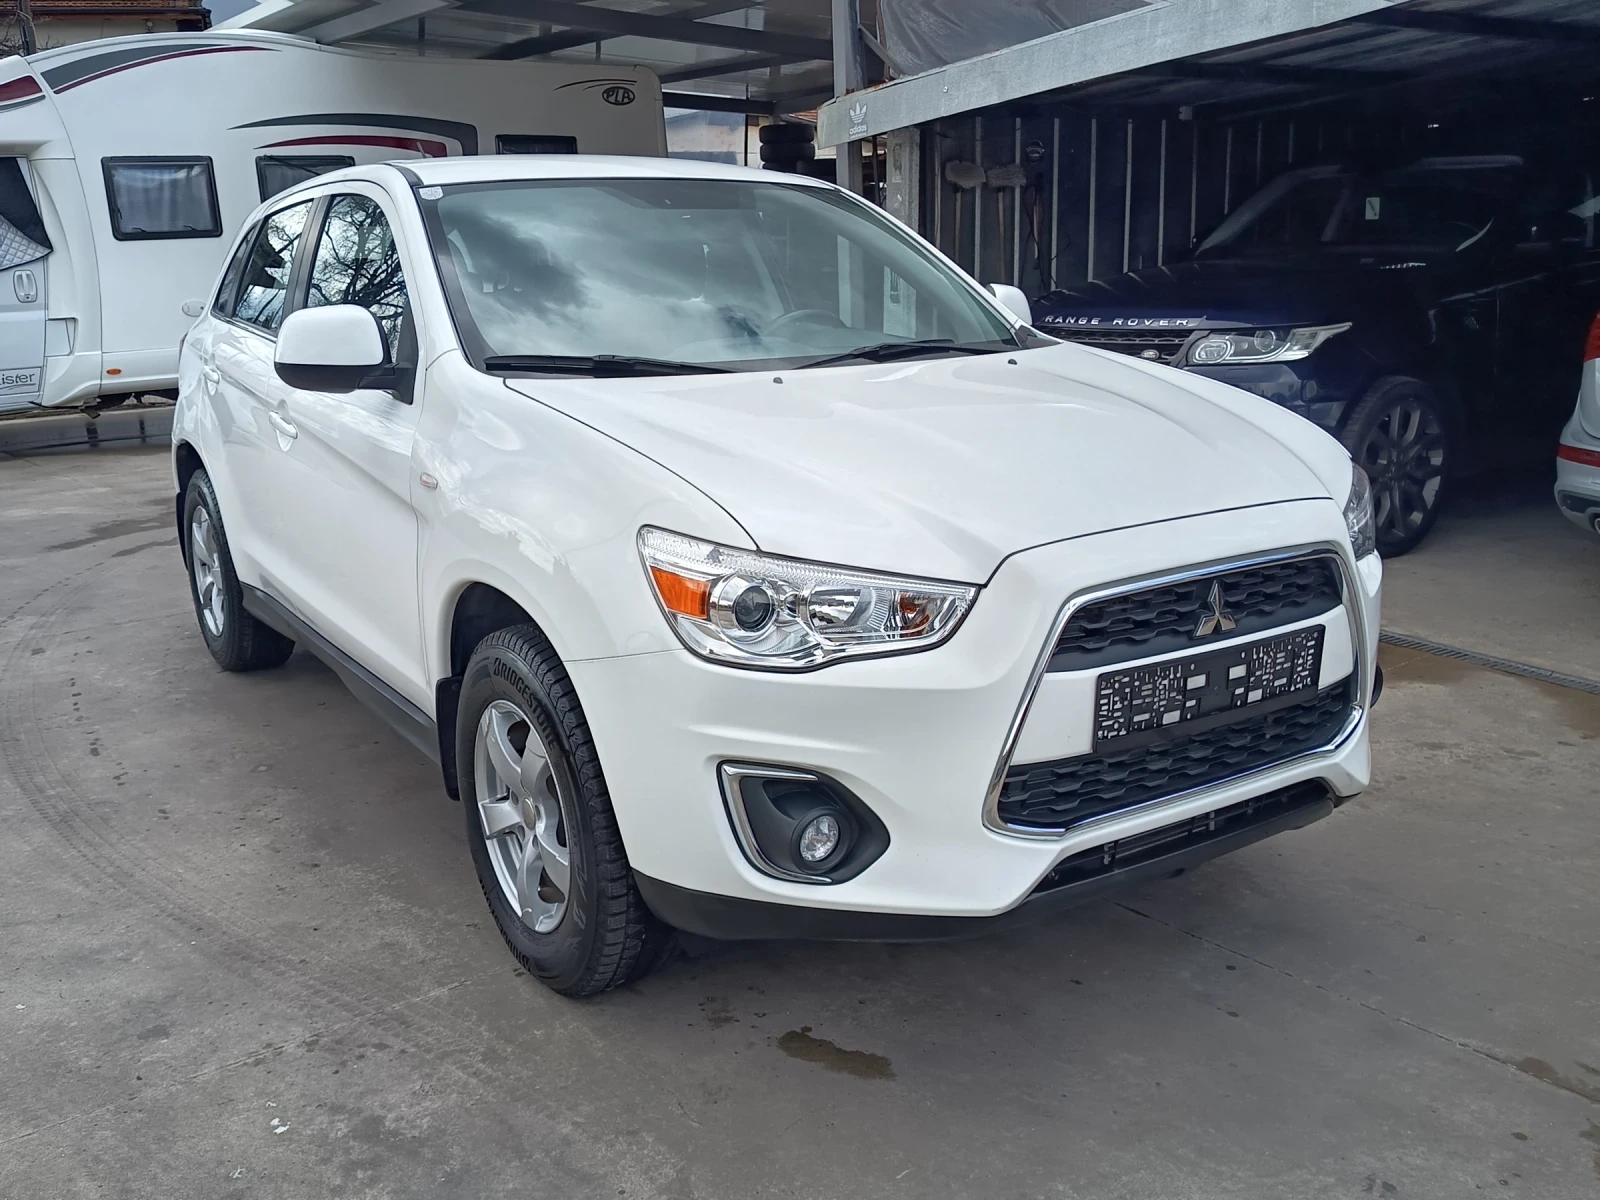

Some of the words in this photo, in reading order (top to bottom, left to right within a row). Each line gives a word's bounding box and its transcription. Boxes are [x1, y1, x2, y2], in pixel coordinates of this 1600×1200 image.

[605, 89, 632, 103] PLA
[1045, 315, 1101, 325] RANGE
[1112, 318, 1189, 326] ROVER
[0, 373, 35, 385] ister
